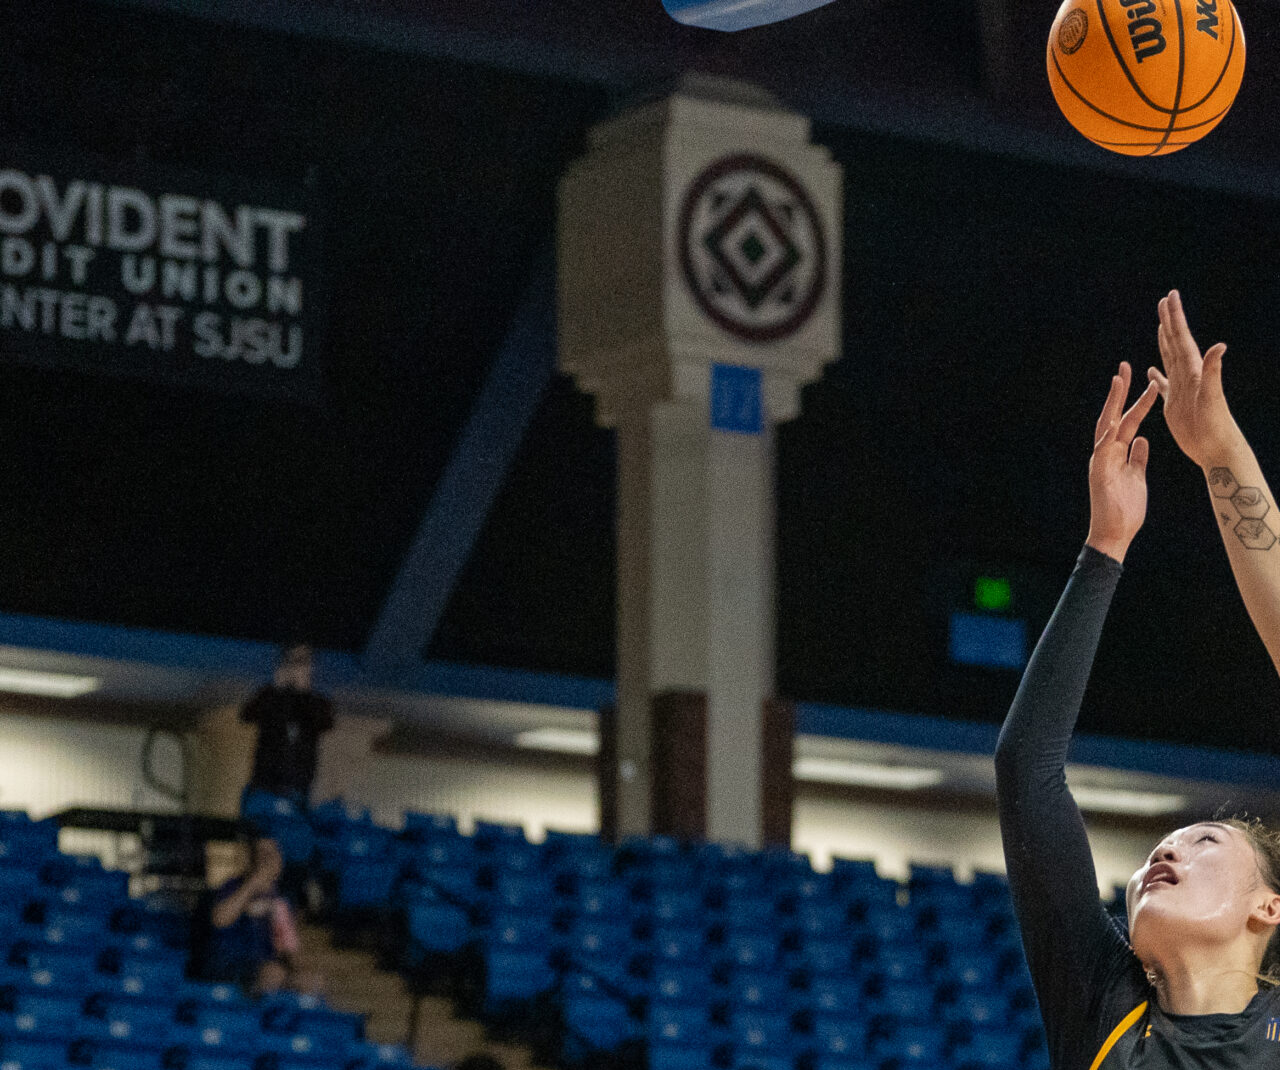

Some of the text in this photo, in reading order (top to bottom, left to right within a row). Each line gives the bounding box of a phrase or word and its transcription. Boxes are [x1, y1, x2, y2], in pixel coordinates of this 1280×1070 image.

[0, 168, 306, 273] OVIDENT
[121, 254, 303, 315] UNION
[124, 303, 186, 352] AT
[193, 311, 303, 369] SJSU
